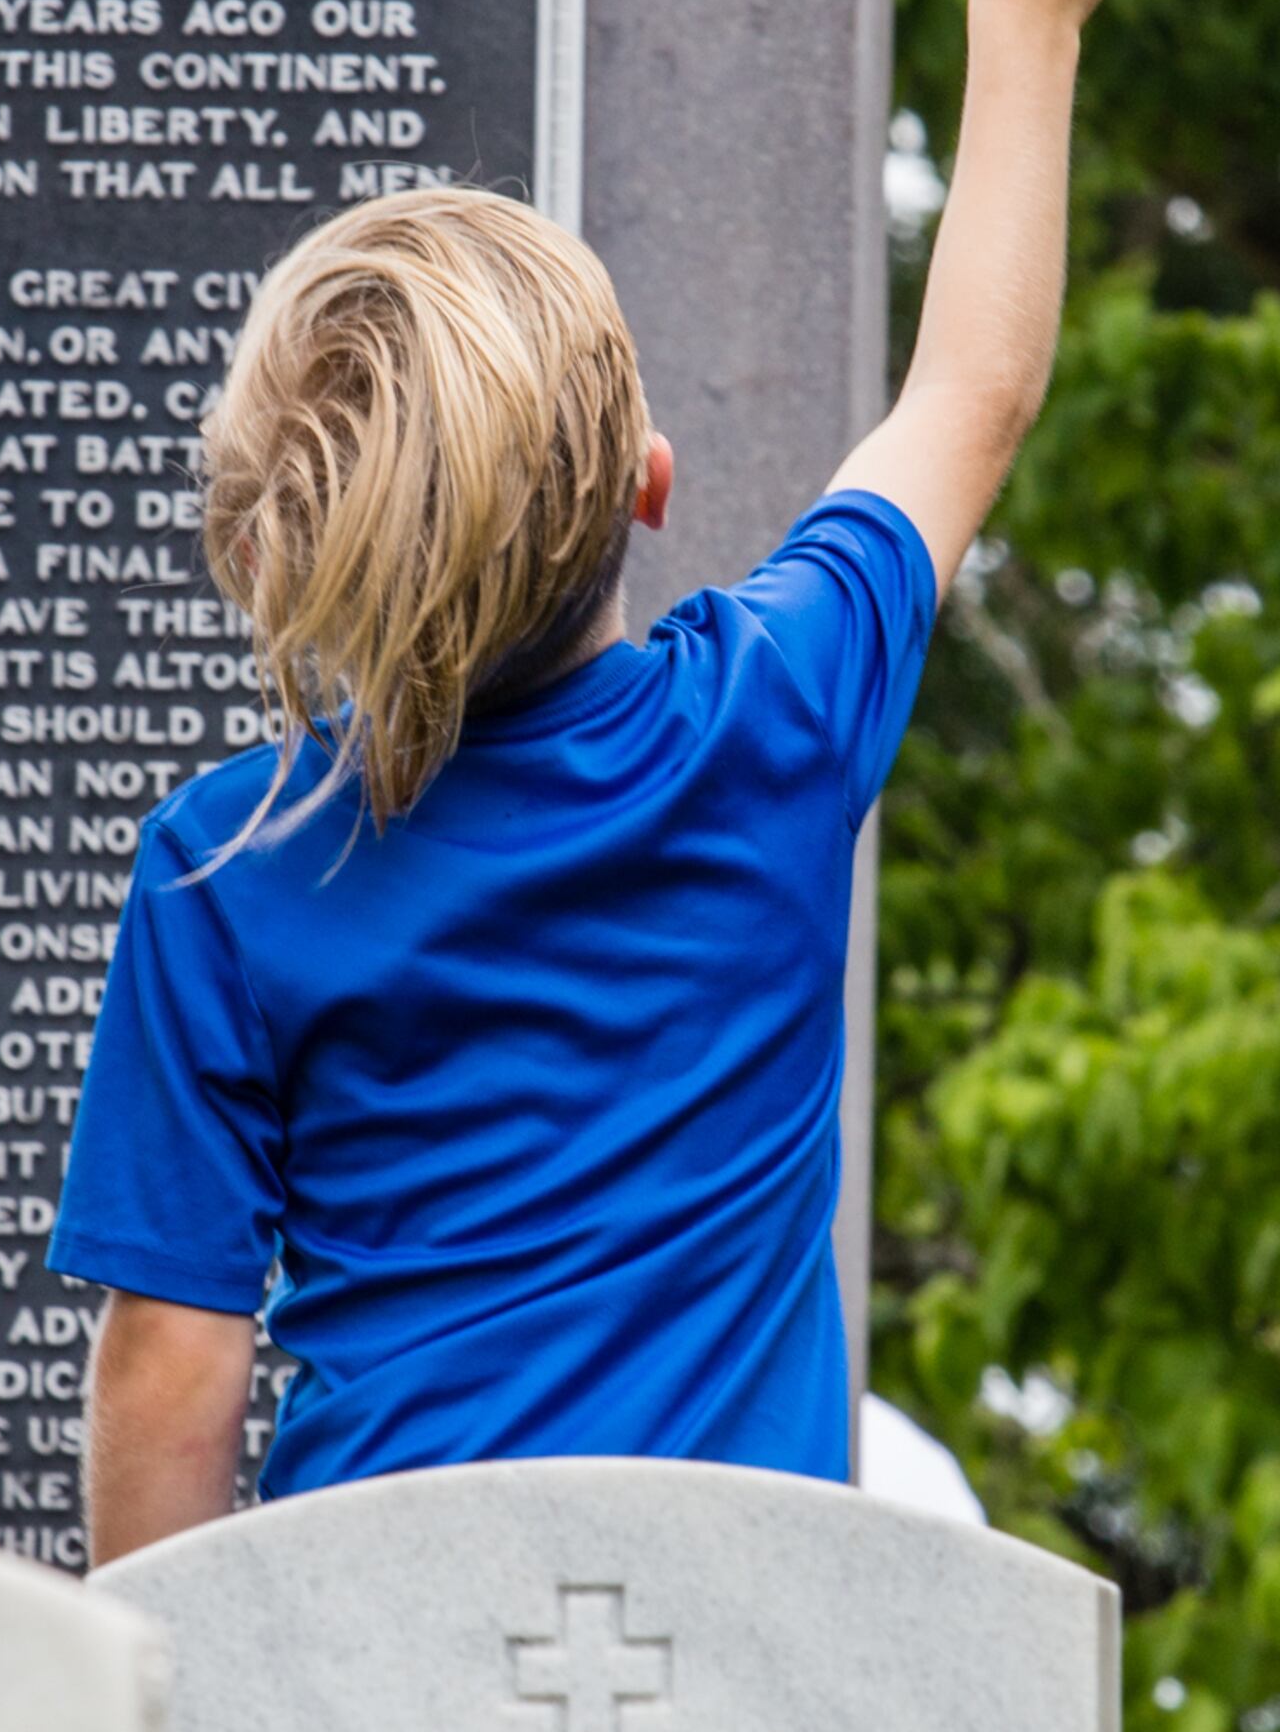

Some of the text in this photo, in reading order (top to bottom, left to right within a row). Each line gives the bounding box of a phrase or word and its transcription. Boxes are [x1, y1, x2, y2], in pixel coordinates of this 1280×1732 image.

[312, 0, 417, 38] OUR
[314, 109, 425, 148] AND
[61, 159, 195, 199] THAT
[210, 162, 314, 201] ALL
[339, 163, 453, 201] MEN
[10, 269, 178, 309] GREAT
[50, 325, 117, 365] OR
[140, 328, 238, 365] ANY
[76, 435, 203, 474] BATT
[40, 489, 114, 529] TO
[136, 489, 203, 530] DE
[37, 545, 191, 584] FINAL
[52, 649, 96, 689] IS
[1, 704, 205, 746] SHOULD
[224, 706, 287, 746] DO
[76, 760, 181, 800] NOT
[70, 816, 139, 856] NO
[10, 977, 107, 1016] ADD
[27, 1415, 85, 1455] US
